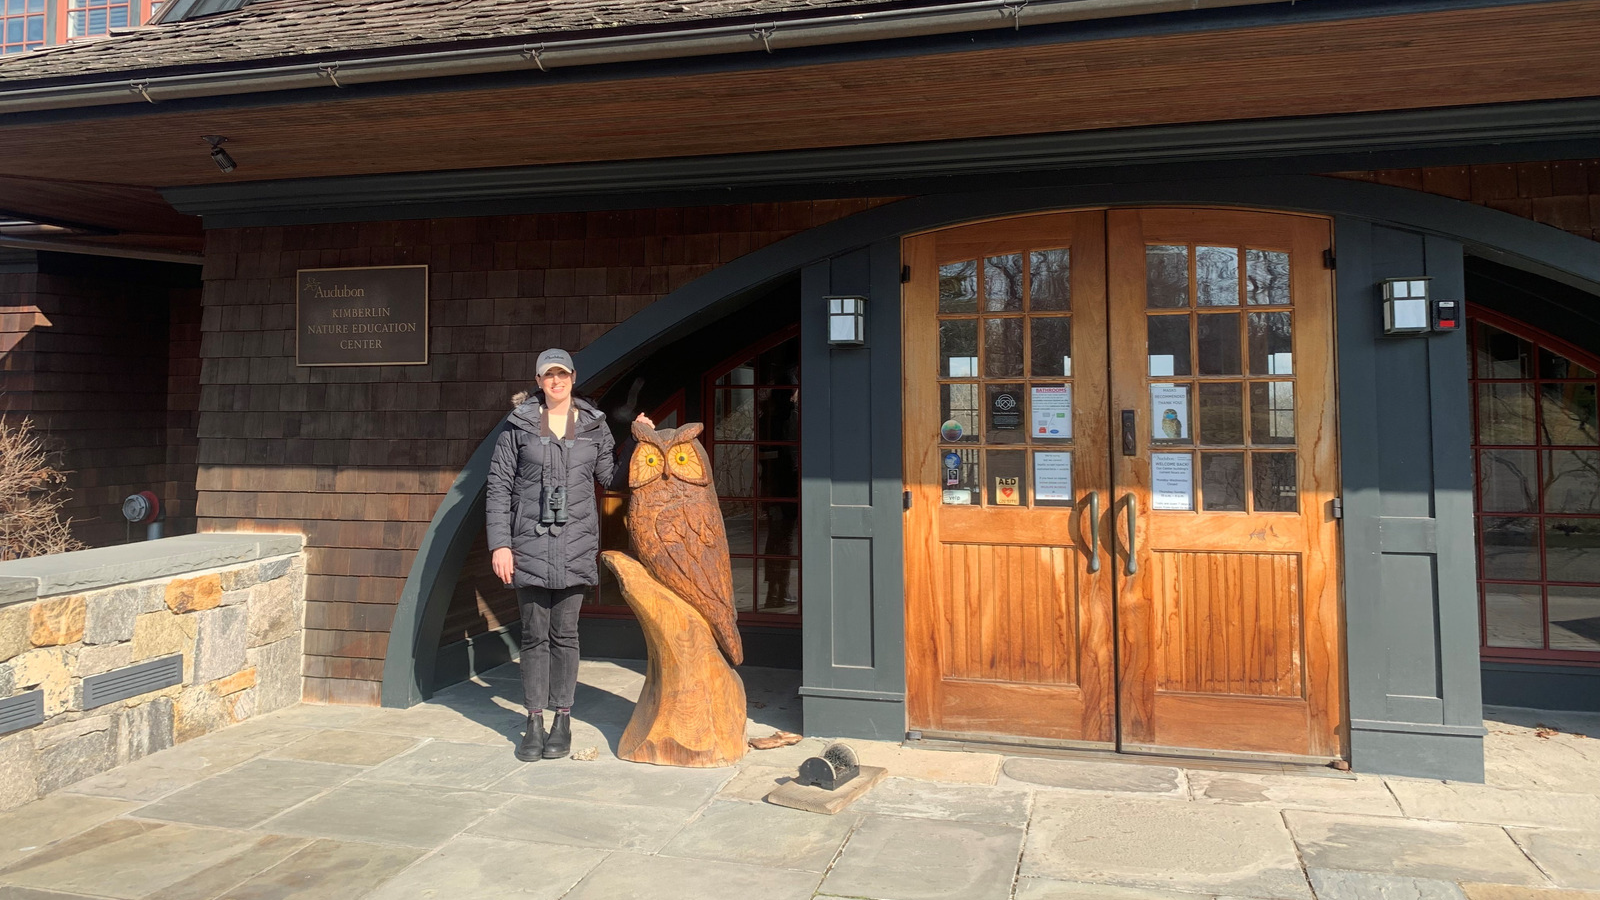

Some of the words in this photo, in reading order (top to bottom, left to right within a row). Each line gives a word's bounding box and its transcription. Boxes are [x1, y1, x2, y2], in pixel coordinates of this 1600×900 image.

[314, 284, 365, 298] Audubon
[332, 307, 391, 318] KIMBERLIN
[307, 323, 349, 335] NATURE
[352, 322, 416, 334] EDUCATION
[340, 339, 383, 350] CENTER
